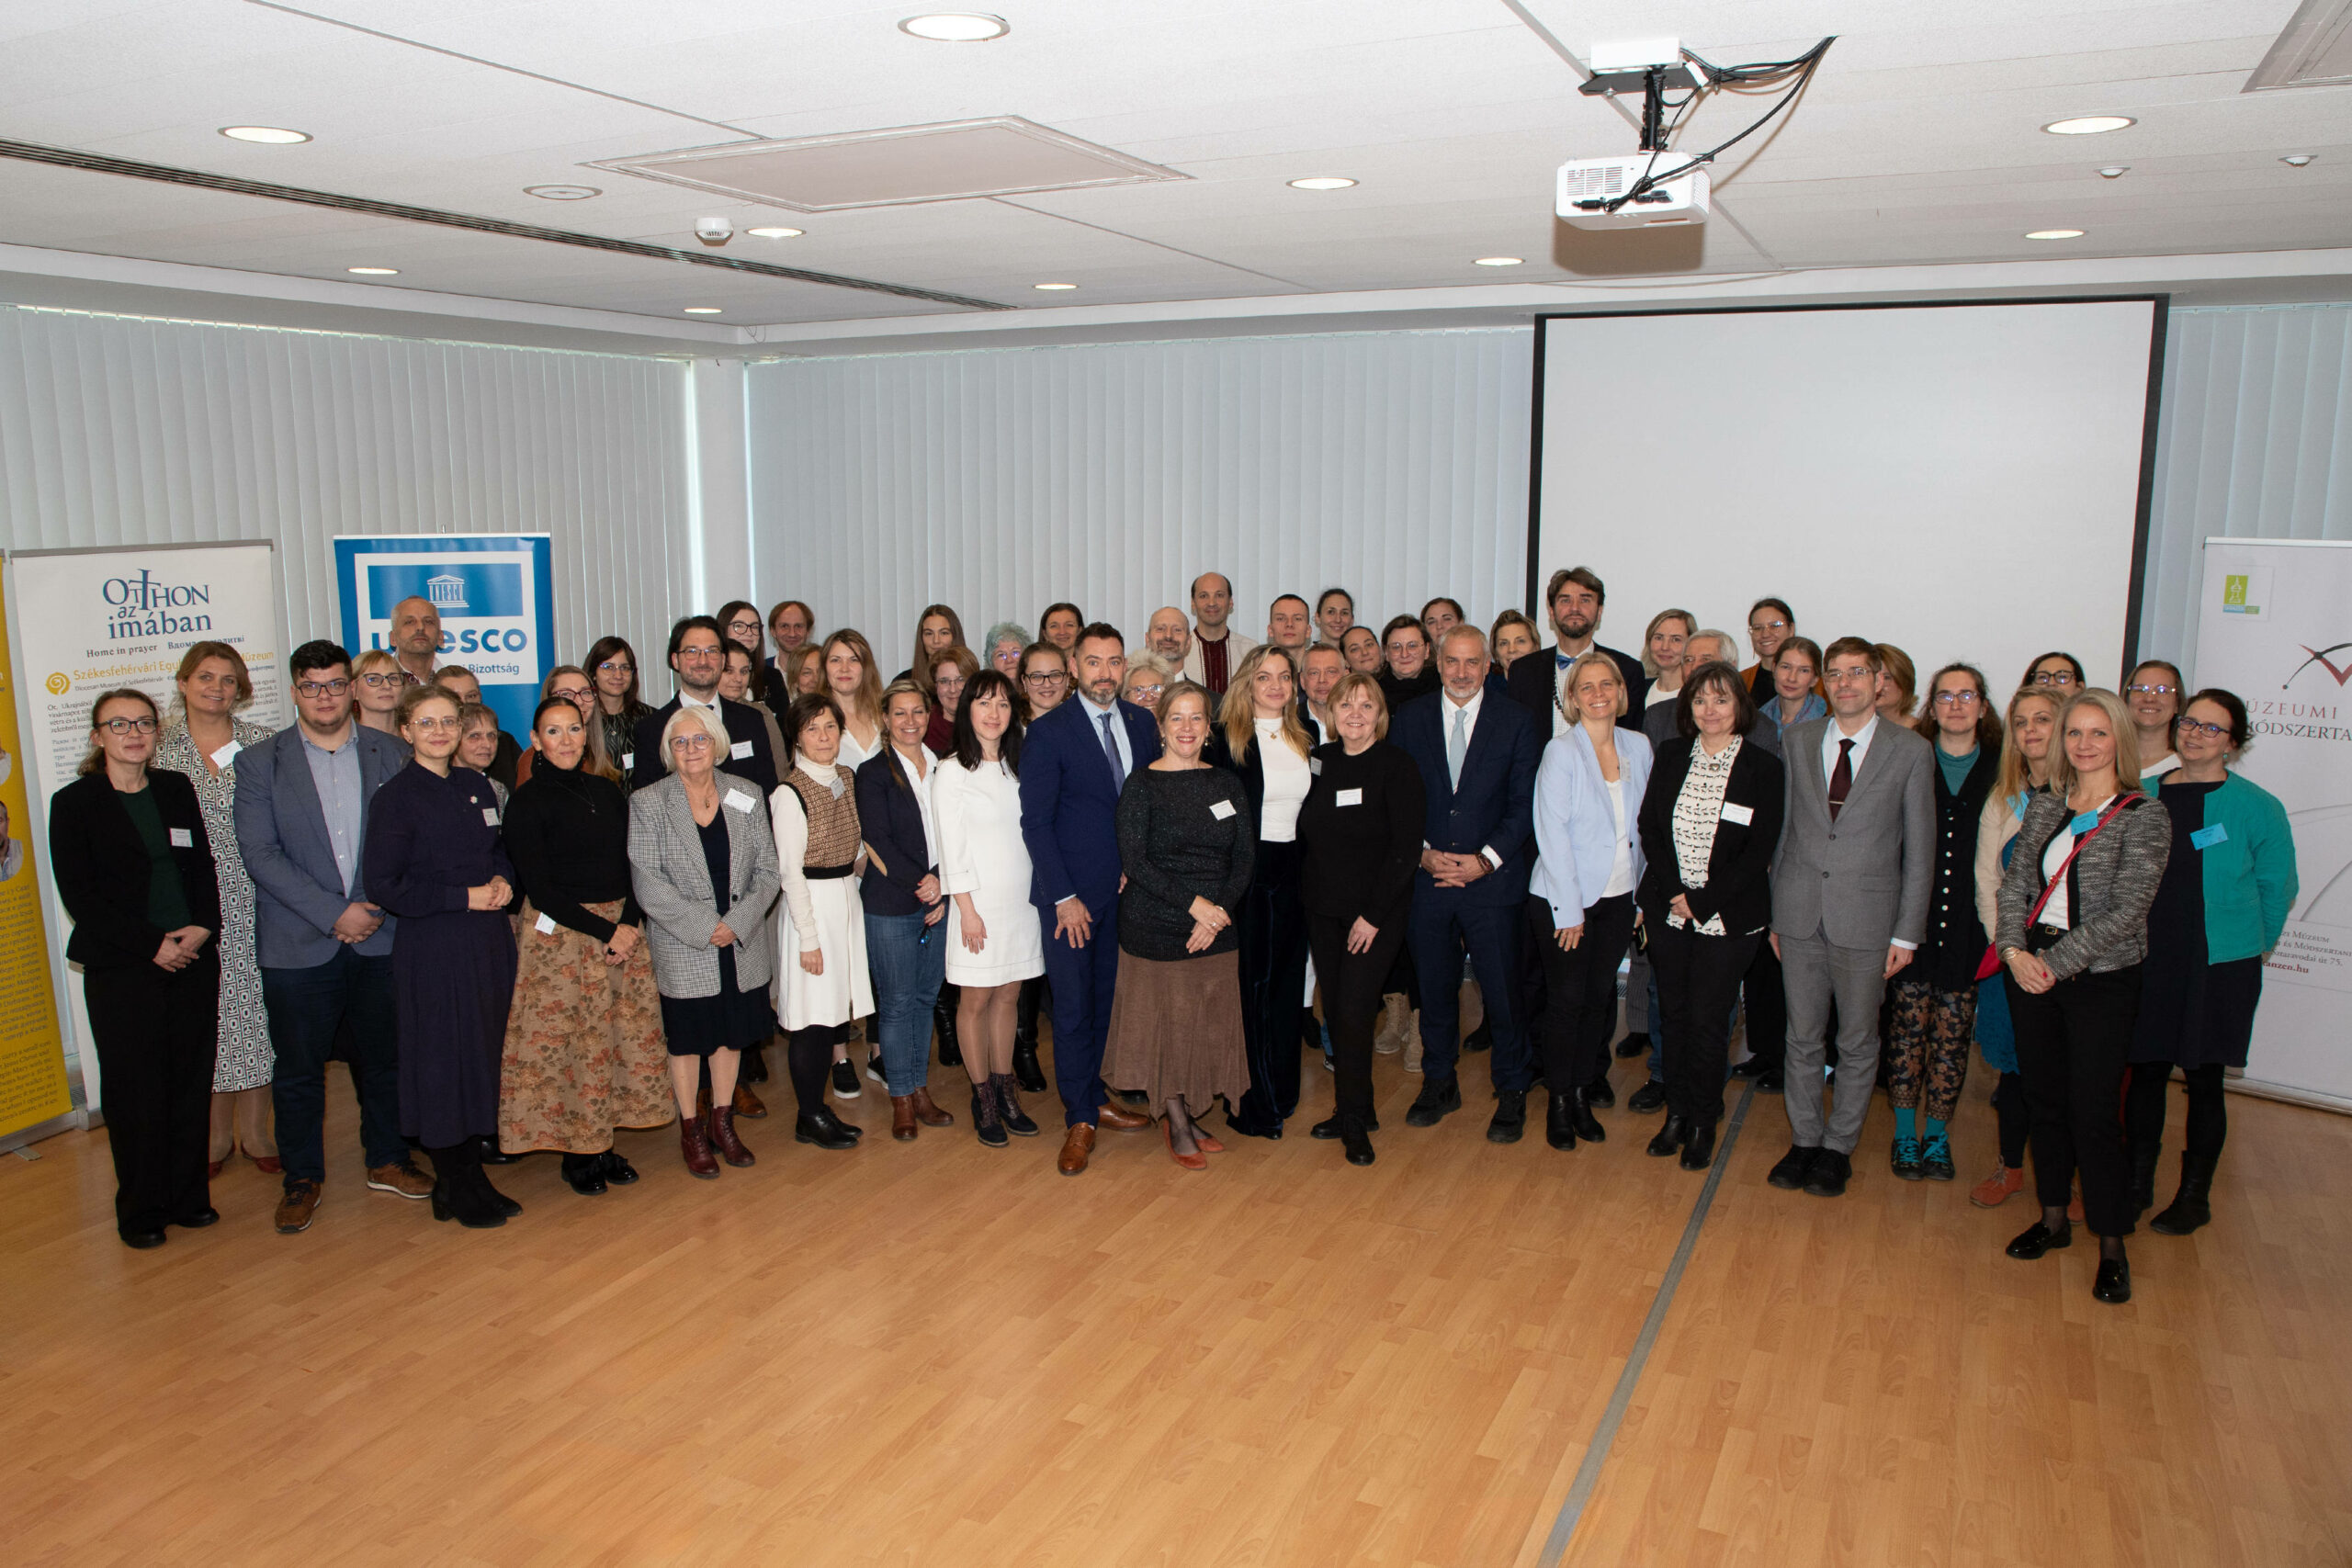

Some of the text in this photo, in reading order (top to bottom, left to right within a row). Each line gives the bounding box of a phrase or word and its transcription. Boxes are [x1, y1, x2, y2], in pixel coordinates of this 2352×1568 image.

[118, 605, 138, 619] az
[107, 610, 213, 639] imában
[371, 628, 527, 653] uesco
[86, 645, 158, 659] Home in prayer
[74, 661, 156, 681] Székesfehérvári
[2246, 698, 2336, 719] ÚZEUMI
[2248, 719, 2352, 741] ÓDSZERTA
